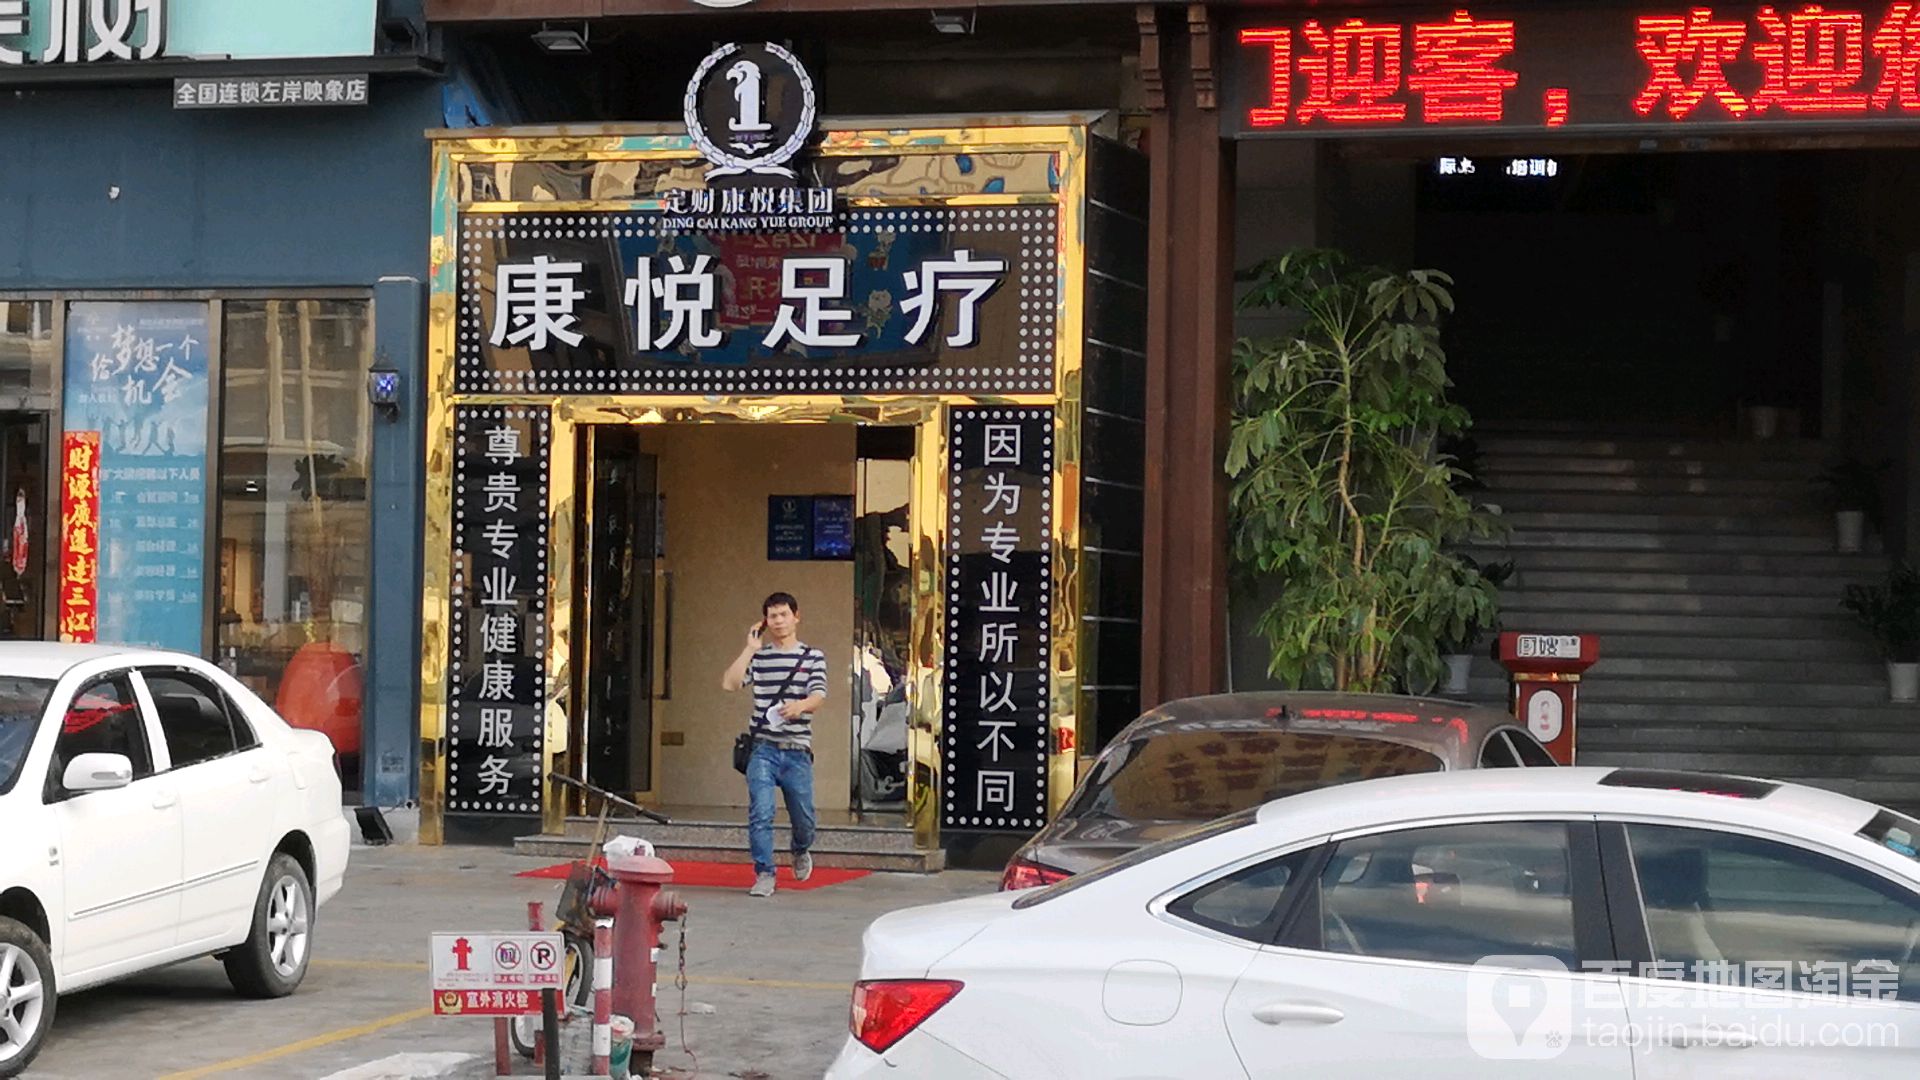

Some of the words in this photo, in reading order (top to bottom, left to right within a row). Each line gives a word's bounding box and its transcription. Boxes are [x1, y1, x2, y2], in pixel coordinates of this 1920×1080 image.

[176, 79, 367, 106] 全国连锁左岸映象店
[1506, 158, 1557, 176] 培训
[663, 217, 693, 229] DING
[697, 217, 719, 229] CAI
[721, 217, 757, 229] KANG
[760, 216, 786, 228] YUE
[789, 215, 833, 228] GROUP
[489, 250, 1005, 352] 康悦足疗
[477, 425, 522, 796] 尊贵专业健康服务
[976, 424, 1021, 812] 因为专业所以不同
